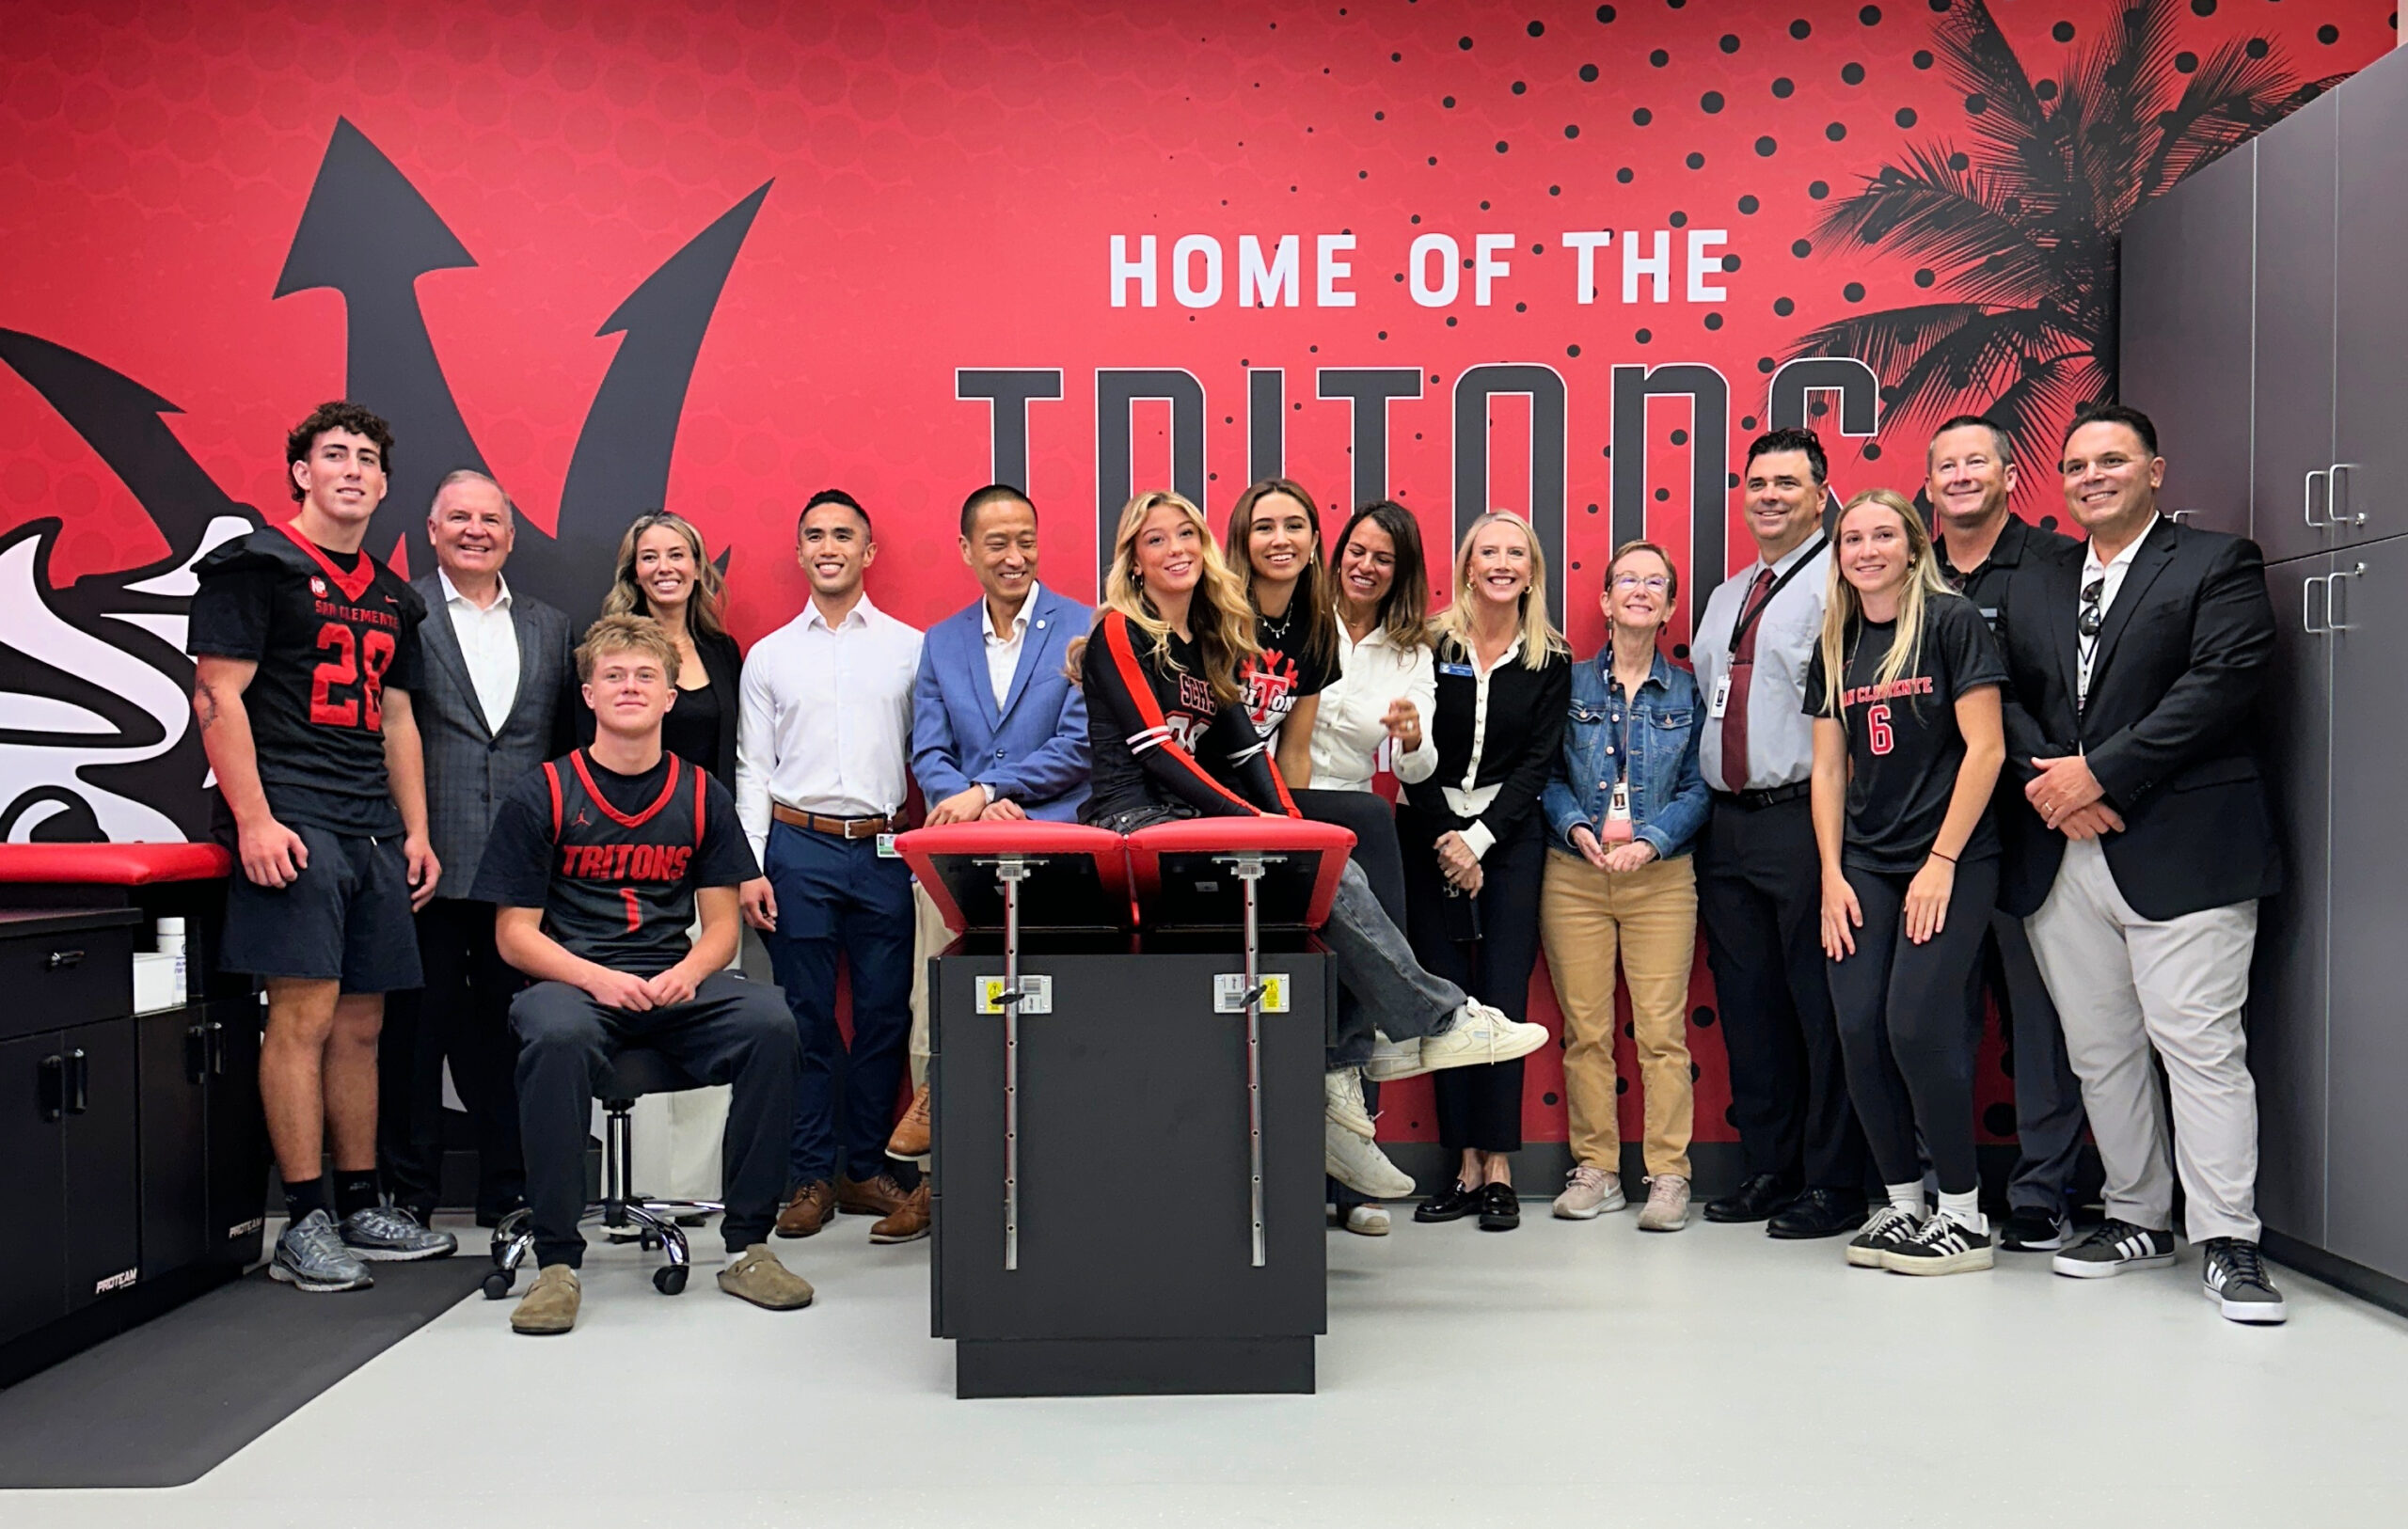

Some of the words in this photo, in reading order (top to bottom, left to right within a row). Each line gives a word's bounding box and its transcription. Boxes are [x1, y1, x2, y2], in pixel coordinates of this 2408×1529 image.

[1109, 233, 1357, 308] HOME
[1408, 231, 1516, 307] OF
[1561, 229, 1729, 306] THE
[309, 622, 396, 733] 28
[1856, 676, 1934, 703] CLEENTE
[1868, 703, 1894, 756] 6
[562, 843, 693, 882] TRITONS
[620, 887, 643, 934] 1
[229, 1216, 262, 1239] PROTEAM
[95, 1266, 138, 1295] PROTEAM
